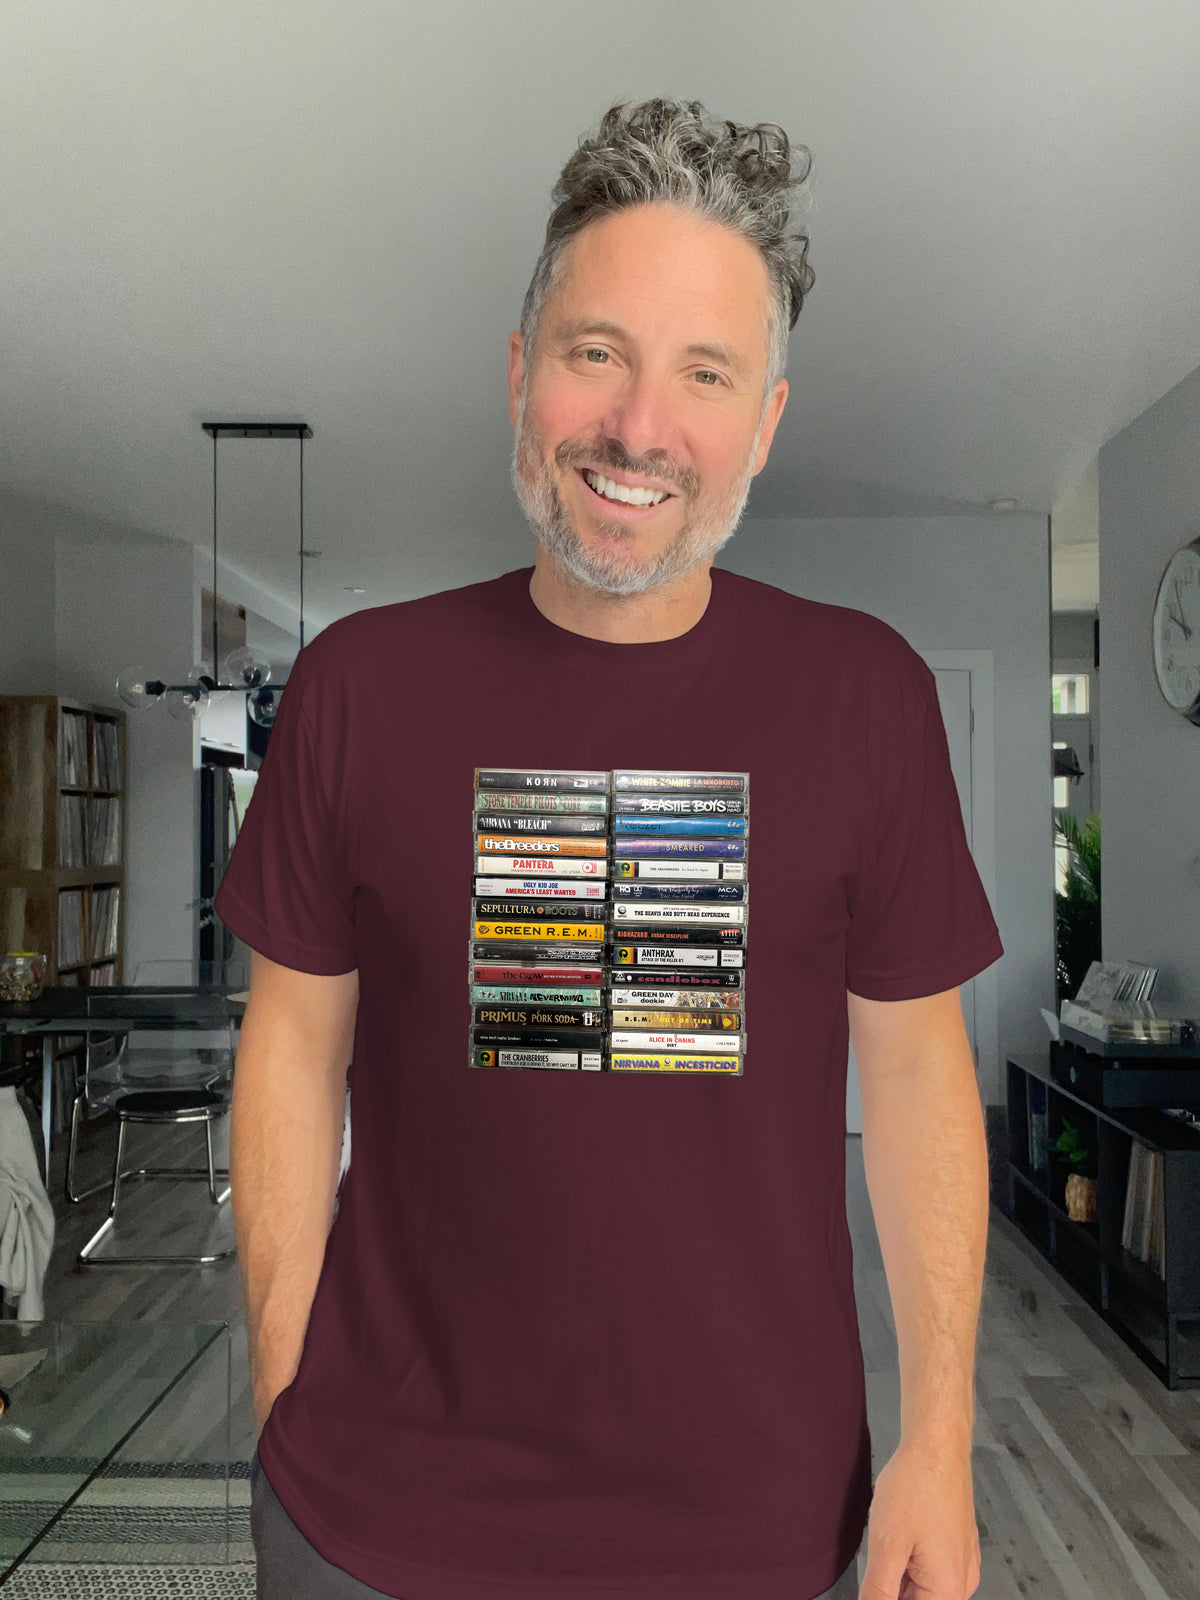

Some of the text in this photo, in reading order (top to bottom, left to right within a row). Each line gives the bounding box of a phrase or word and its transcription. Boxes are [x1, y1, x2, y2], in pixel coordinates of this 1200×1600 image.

[632, 778, 658, 786] WHITE
[660, 778, 690, 788] ZOMBIE
[484, 795, 557, 810] STONE TEMPLE PILOTS
[564, 798, 581, 810] CORE
[640, 798, 726, 812] BEASTIE BOYS
[480, 818, 511, 829] NIRVANA
[513, 860, 554, 870] PANTERA
[481, 904, 535, 914] SEPULTURA
[545, 906, 578, 915] ROOTS
[494, 926, 541, 935] GREEN
[547, 928, 592, 937] R.E.M.
[642, 949, 674, 958] ANTHRAX
[637, 975, 720, 984] candlebox
[500, 992, 527, 1001] NIRVANA
[530, 993, 584, 1002] NEVERMIND
[480, 1011, 527, 1024] PRIMUS
[531, 1014, 575, 1024] PORK SODA
[614, 1059, 660, 1069] NIRVANA
[674, 1060, 737, 1070] INCESTICIDE
